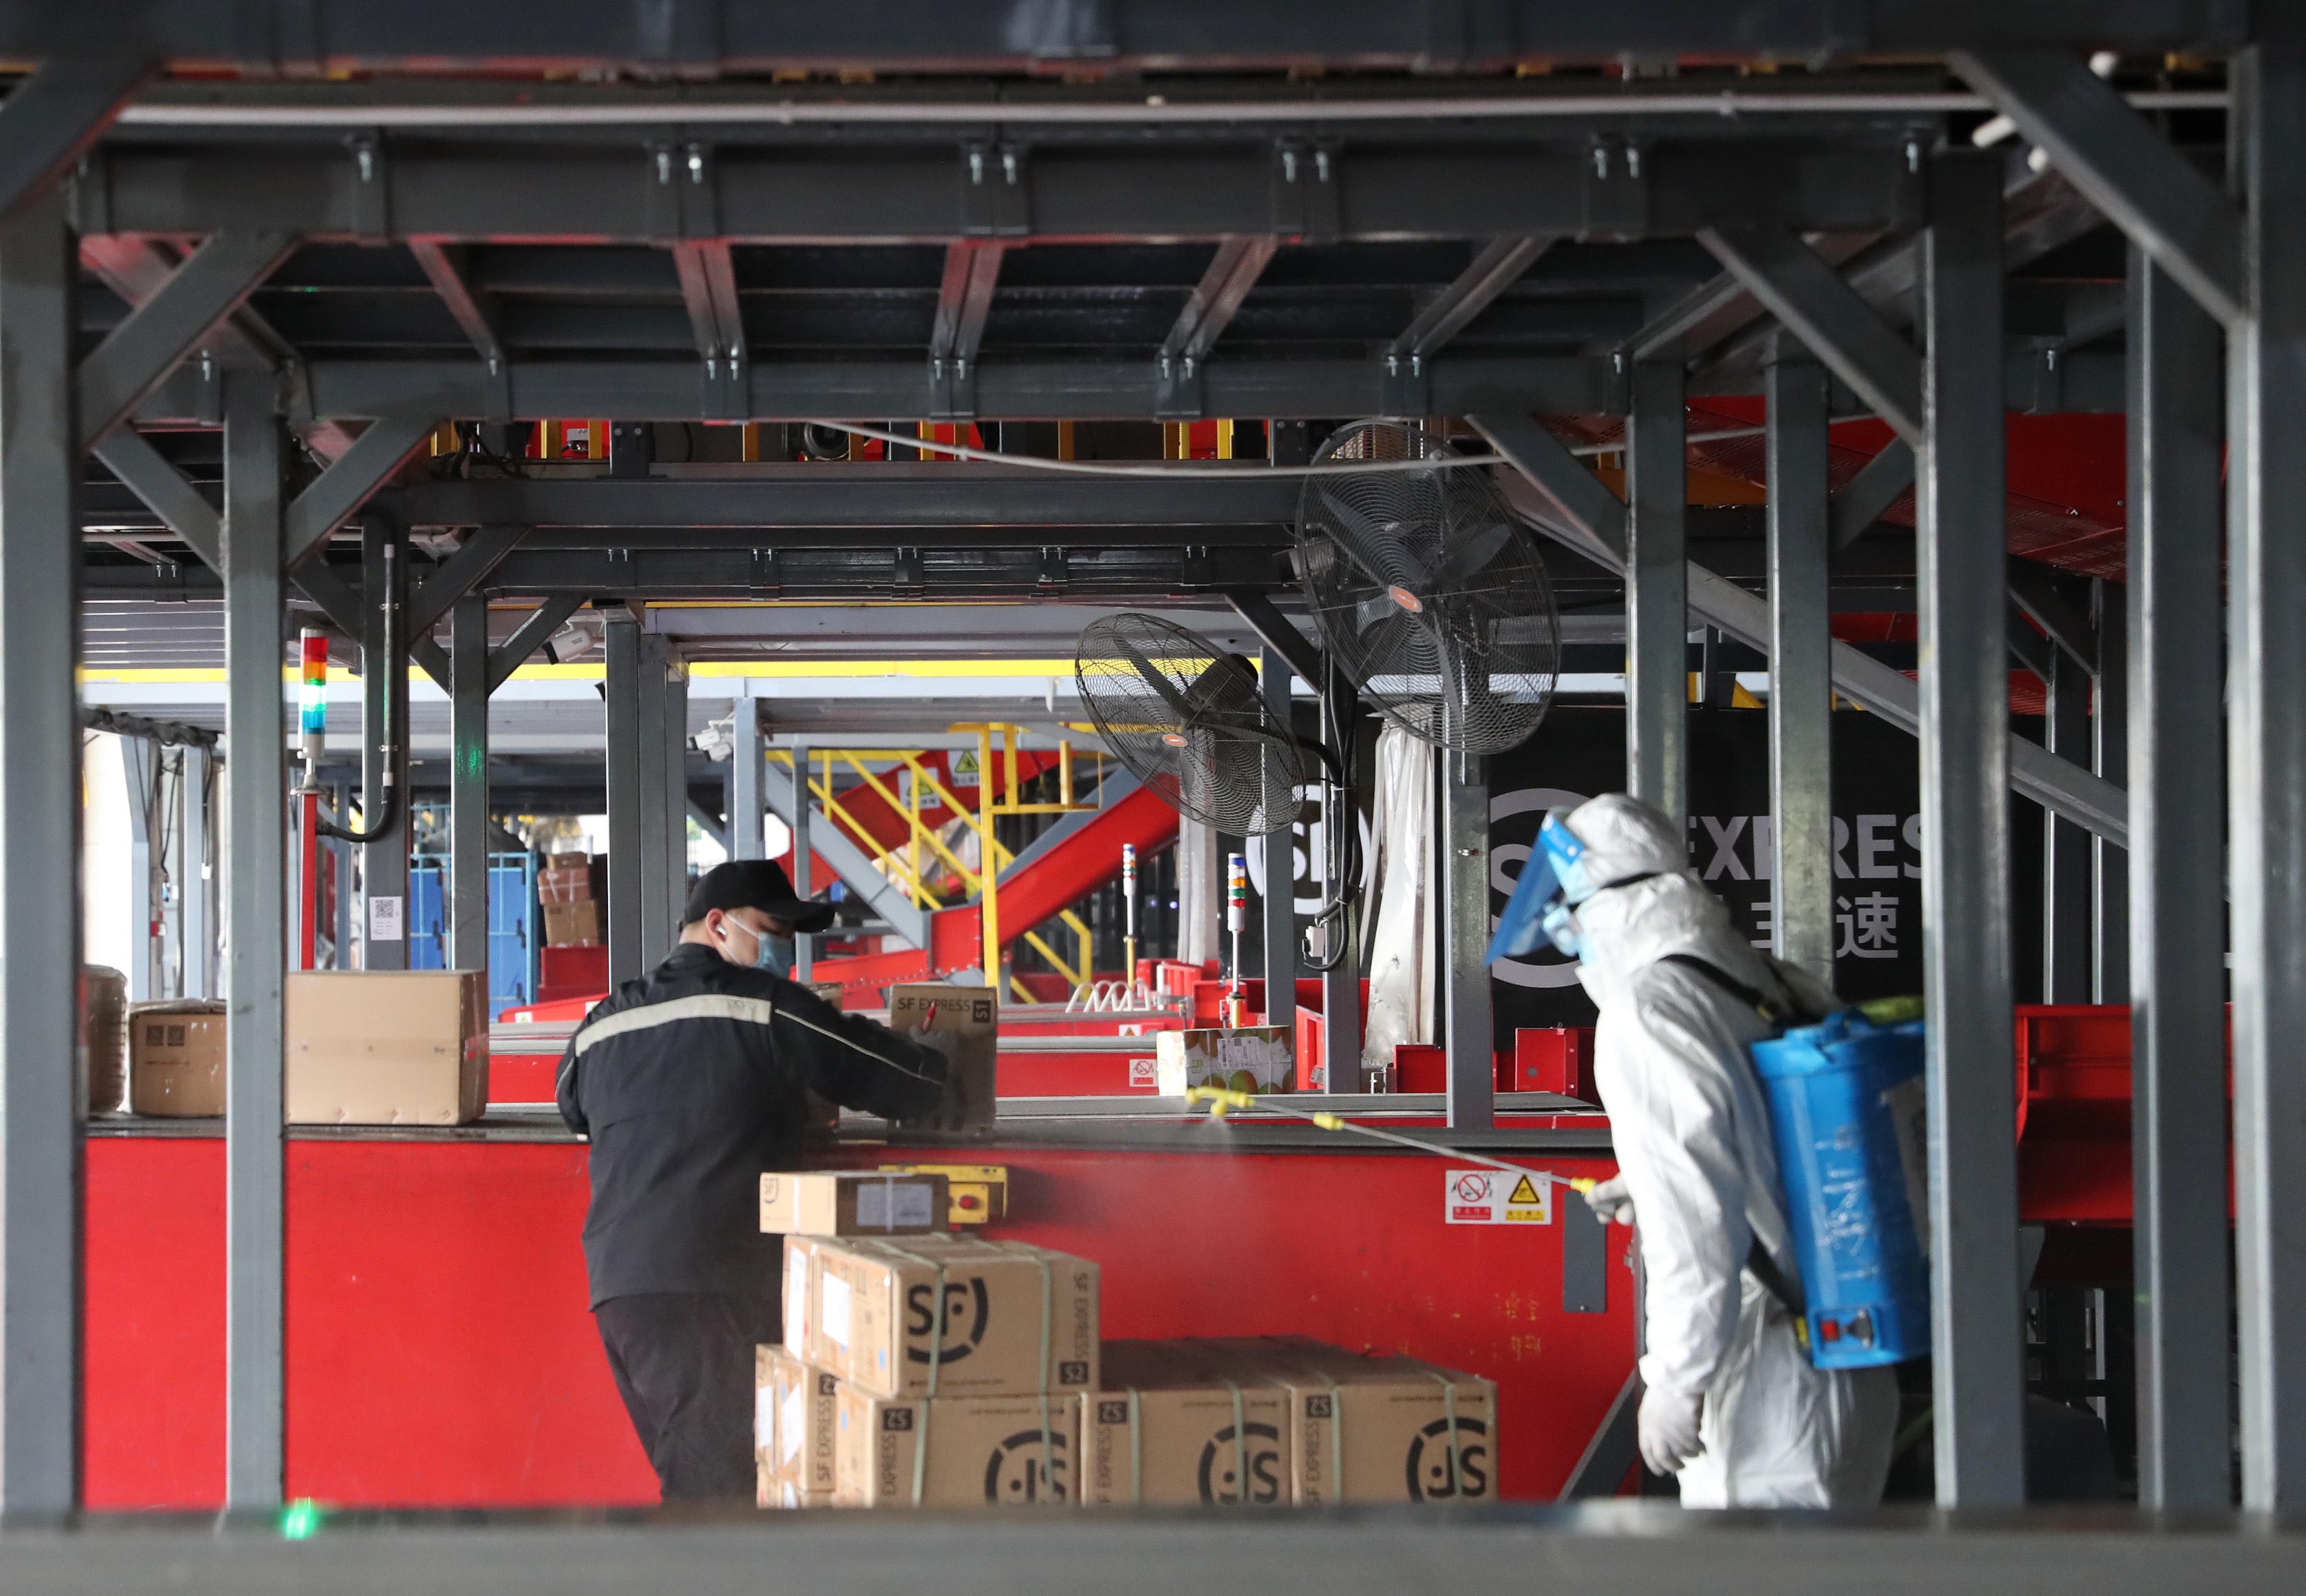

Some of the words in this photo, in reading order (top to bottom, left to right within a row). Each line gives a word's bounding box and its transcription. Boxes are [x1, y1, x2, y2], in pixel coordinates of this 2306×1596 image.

[897, 997, 915, 1011] SF
[919, 998, 971, 1012] EXPRESS
[907, 1282, 968, 1337] SF
[1073, 1273, 1088, 1292] SF
[1073, 1297, 1089, 1359] EXPRESS
[816, 1398, 831, 1458] EXPRESS
[1305, 1420, 1320, 1482] EXPRESS
[816, 1462, 830, 1482] SF
[882, 1433, 897, 1496] EXPRESS
[1096, 1427, 1111, 1488] EXPRESS
[1427, 1446, 1487, 1497] SF
